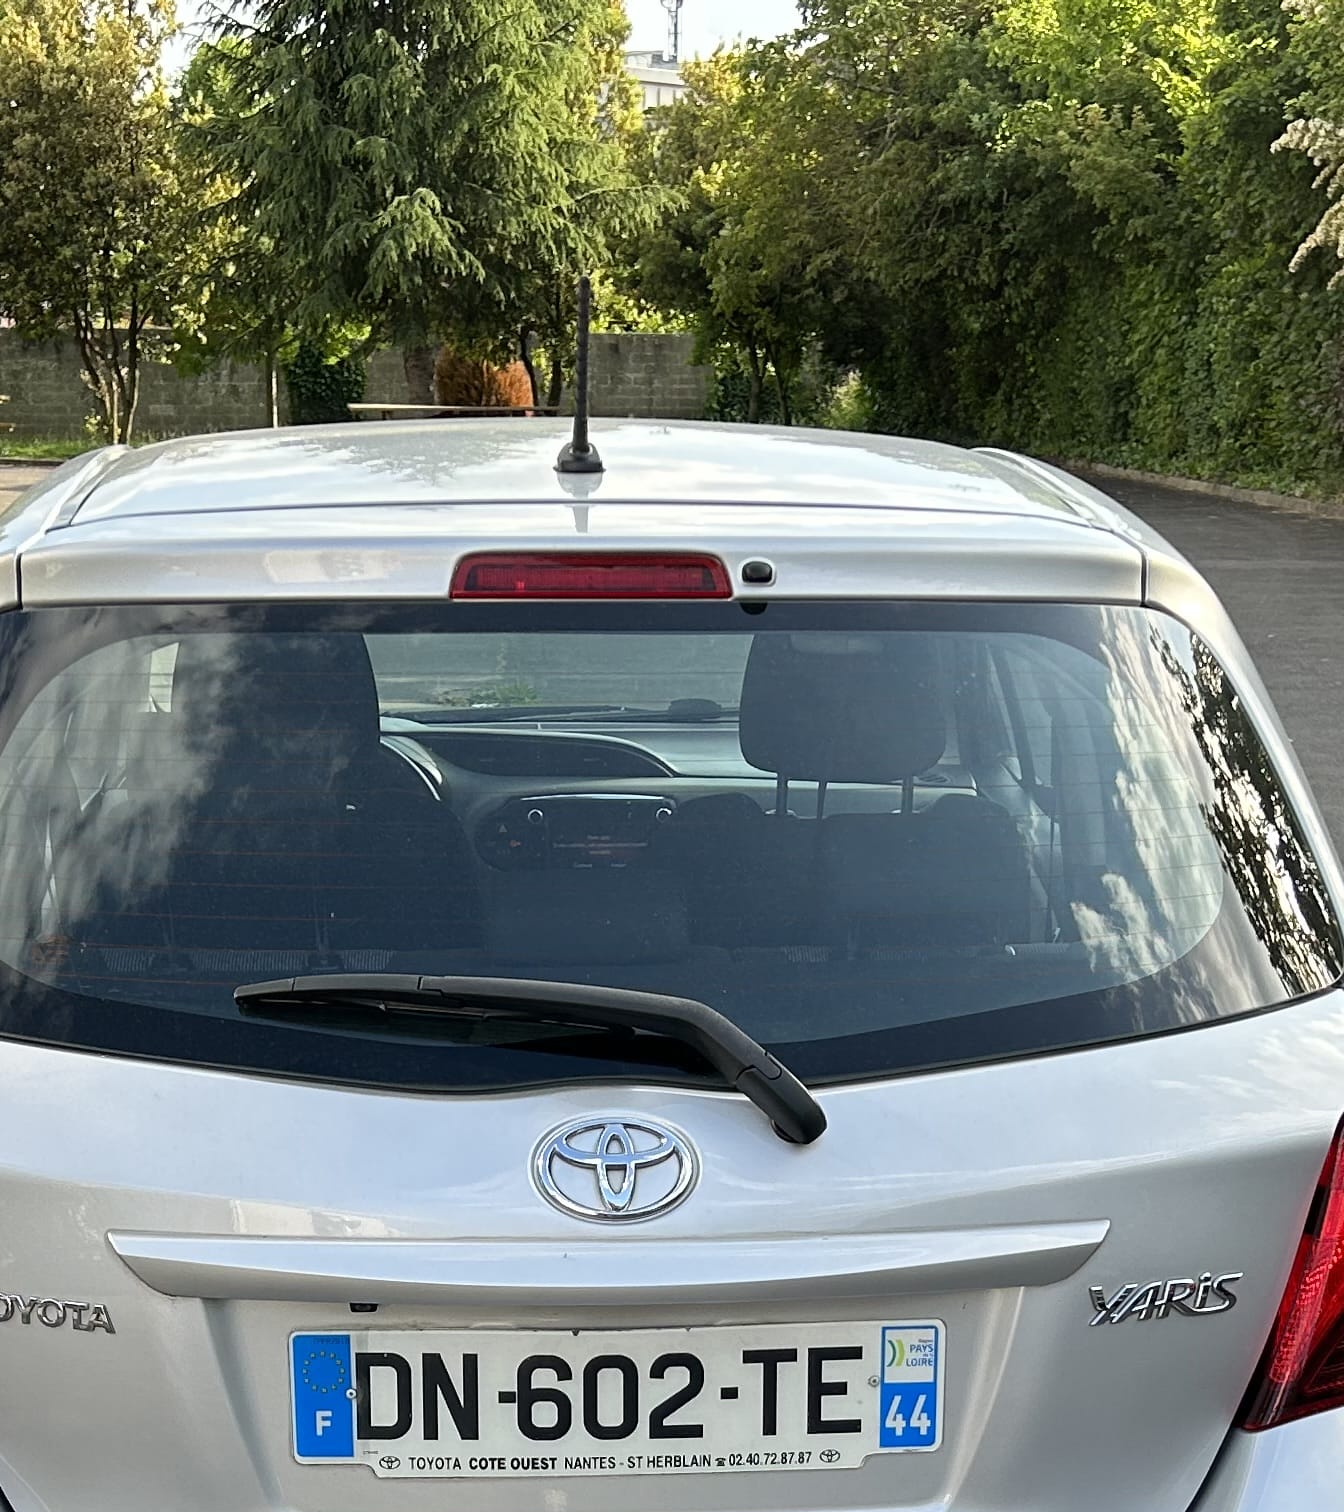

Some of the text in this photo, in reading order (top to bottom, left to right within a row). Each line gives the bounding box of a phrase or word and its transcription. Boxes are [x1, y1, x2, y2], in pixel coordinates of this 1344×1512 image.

[909, 1343, 934, 1354] PAYS
[905, 1357, 934, 1368] LOIRE
[355, 1346, 864, 1441] DN-602-TE
[315, 1410, 333, 1437] F
[884, 1394, 932, 1437] 44
[408, 1456, 462, 1470] TOYOTA
[468, 1456, 507, 1470] COTE
[510, 1456, 558, 1470] OUEST
[564, 1455, 616, 1470] NANTES
[627, 1455, 643, 1469] ST
[646, 1454, 712, 1468] HERBLAIN
[728, 1451, 813, 1467] 02.40.72.87.87
